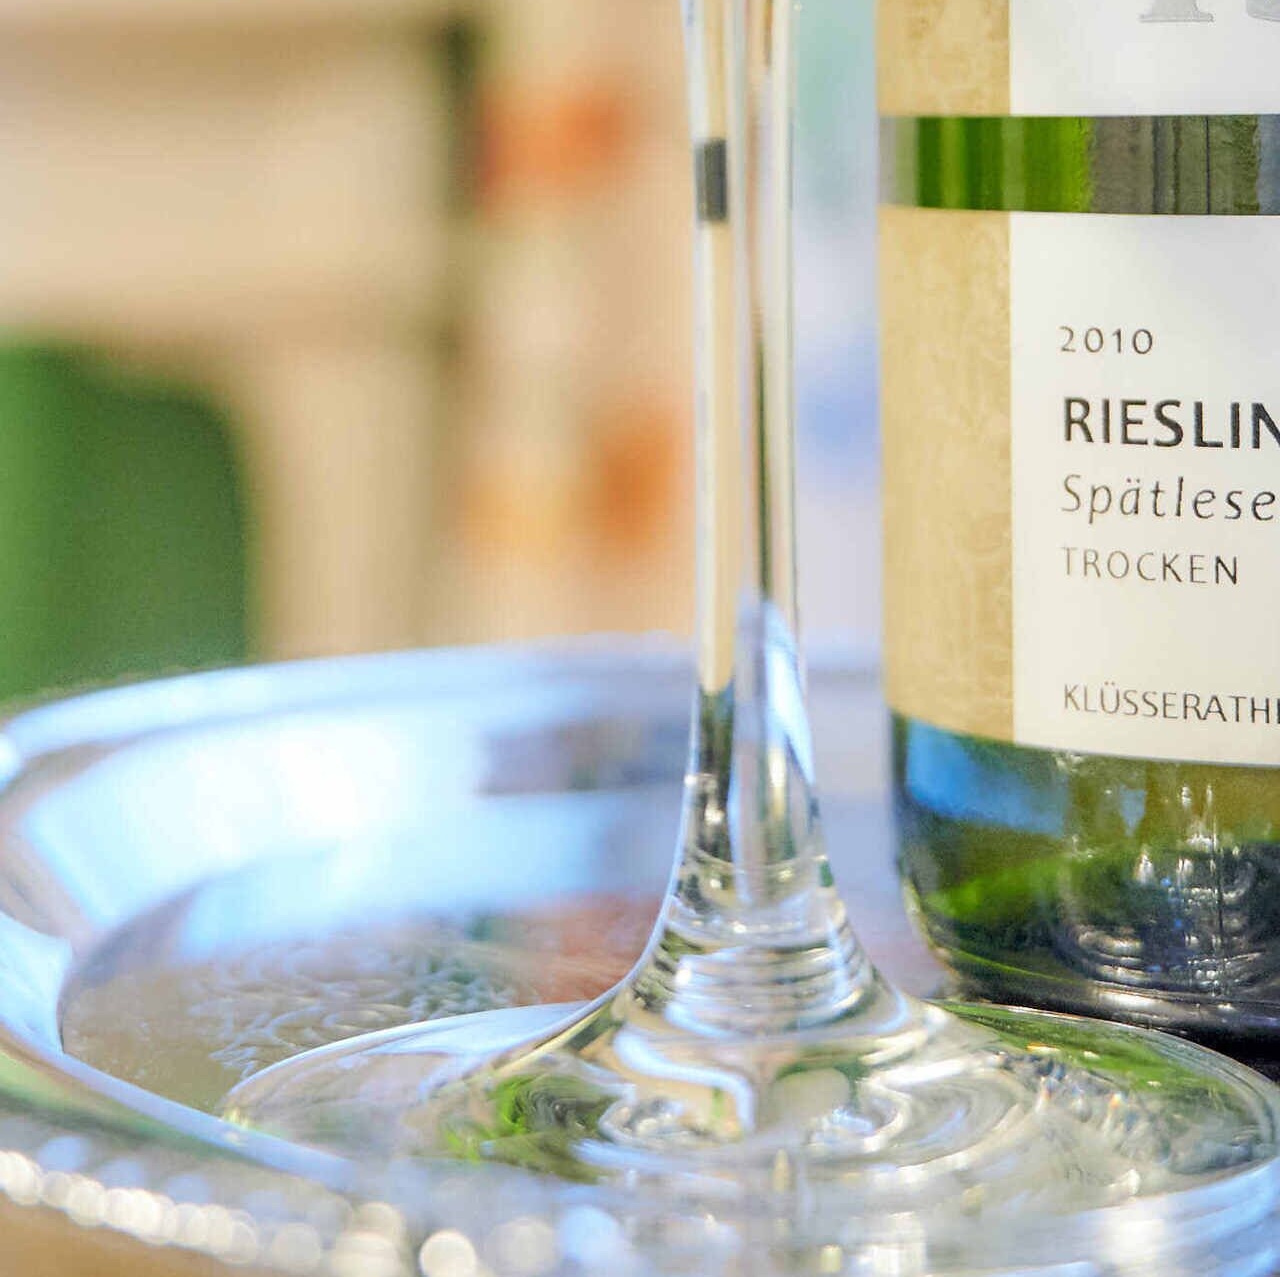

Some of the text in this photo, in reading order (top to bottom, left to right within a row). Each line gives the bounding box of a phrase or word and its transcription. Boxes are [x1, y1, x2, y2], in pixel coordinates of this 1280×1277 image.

[1060, 326, 1153, 354] 2010
[1062, 474, 1276, 524] Spätlese
[1061, 546, 1238, 584] TROCKEN
